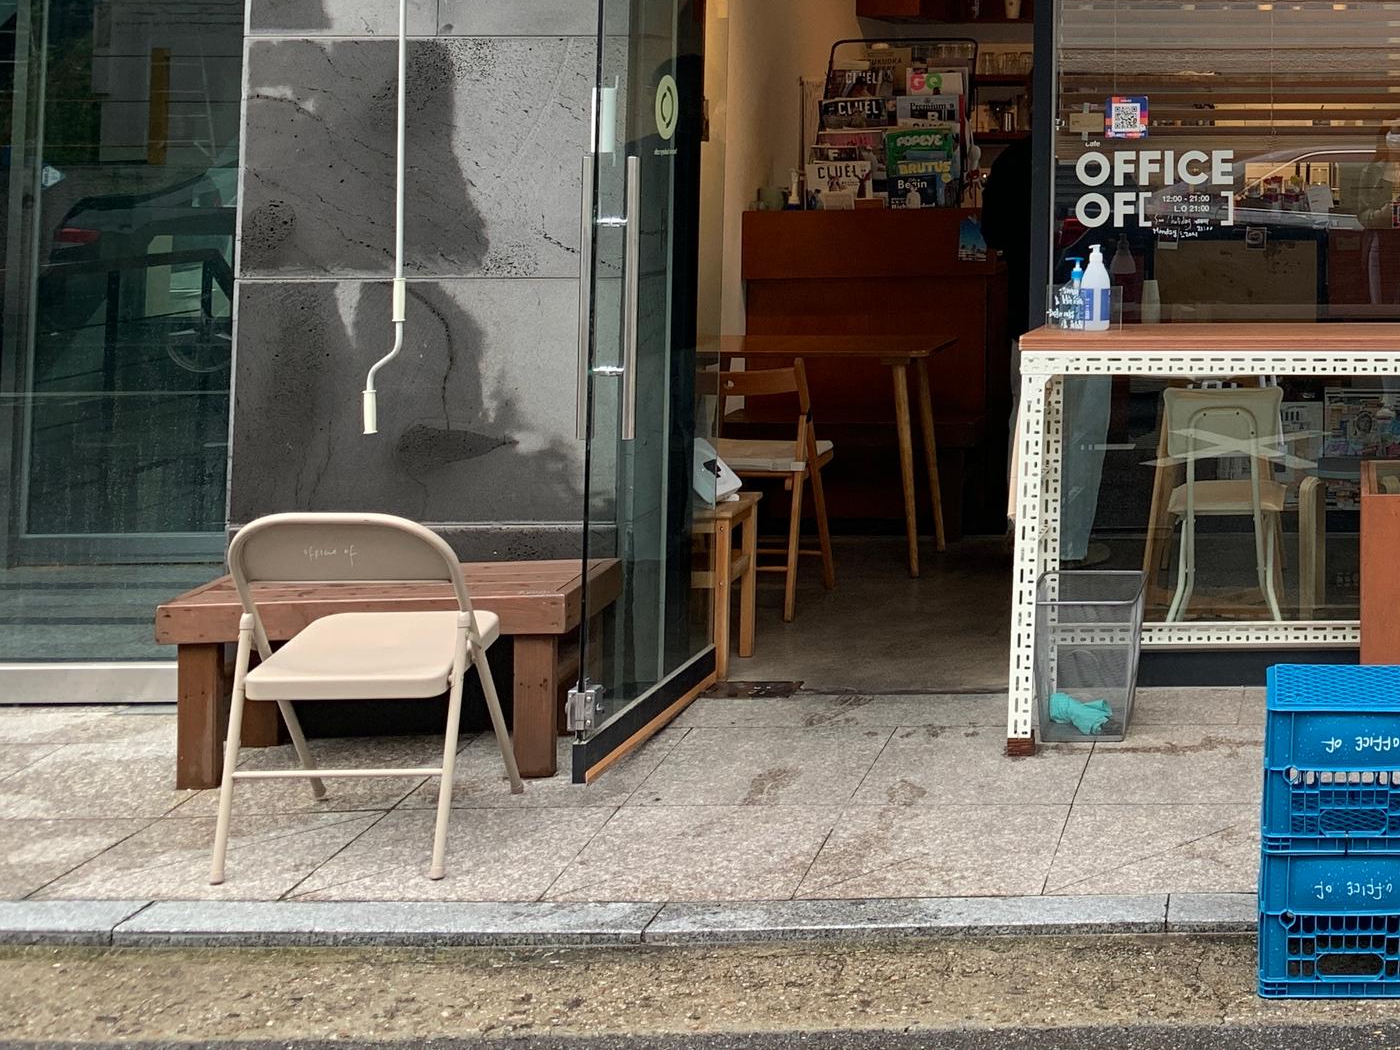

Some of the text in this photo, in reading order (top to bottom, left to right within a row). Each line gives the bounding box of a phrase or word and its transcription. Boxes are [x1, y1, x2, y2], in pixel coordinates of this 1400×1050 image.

[910, 102, 947, 110] Premium
[896, 134, 944, 147] POPEYE
[898, 160, 952, 175] BRUTUS
[1075, 150, 1234, 187] OFFICE
[1189, 194, 1210, 202] 21:00
